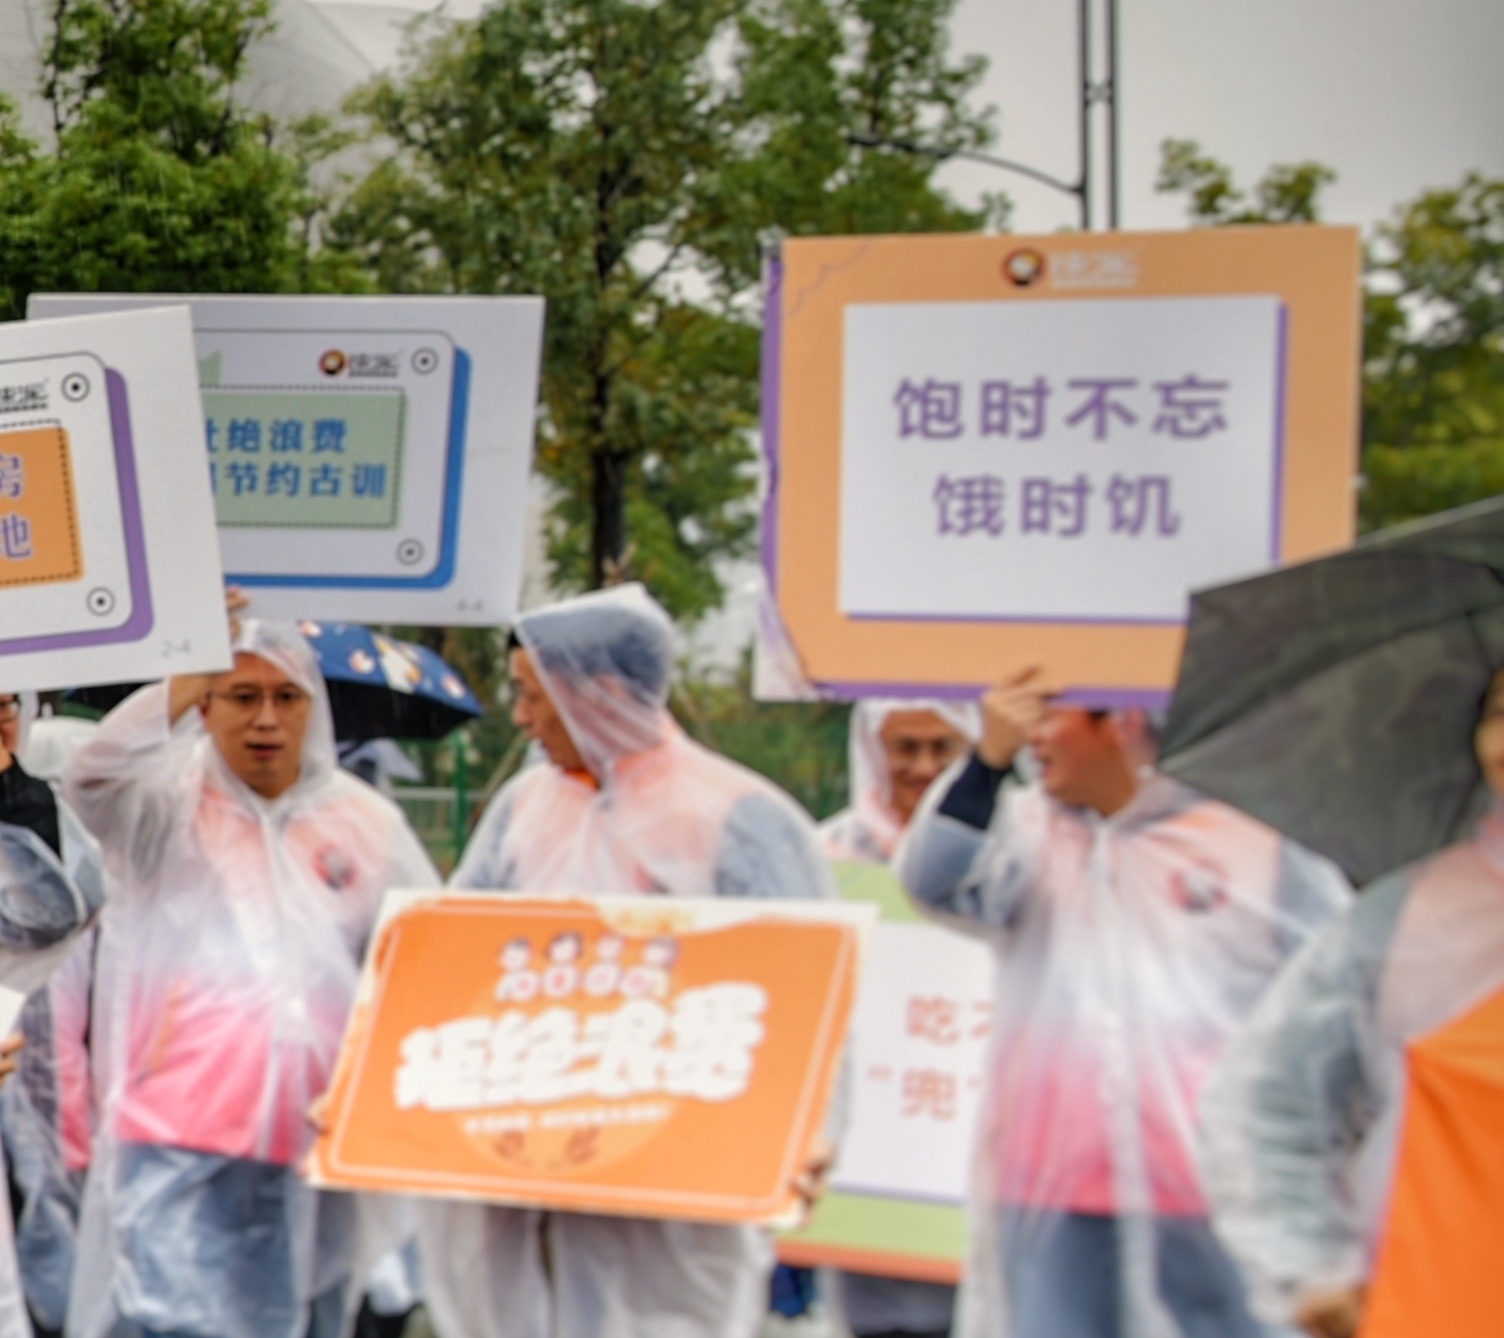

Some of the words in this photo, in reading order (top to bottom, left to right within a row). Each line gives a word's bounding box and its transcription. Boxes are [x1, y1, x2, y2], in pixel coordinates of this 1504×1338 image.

[892, 374, 1231, 443] 饱时不忘
[209, 460, 387, 499] 节约古训
[931, 472, 1183, 541] 饿时饥
